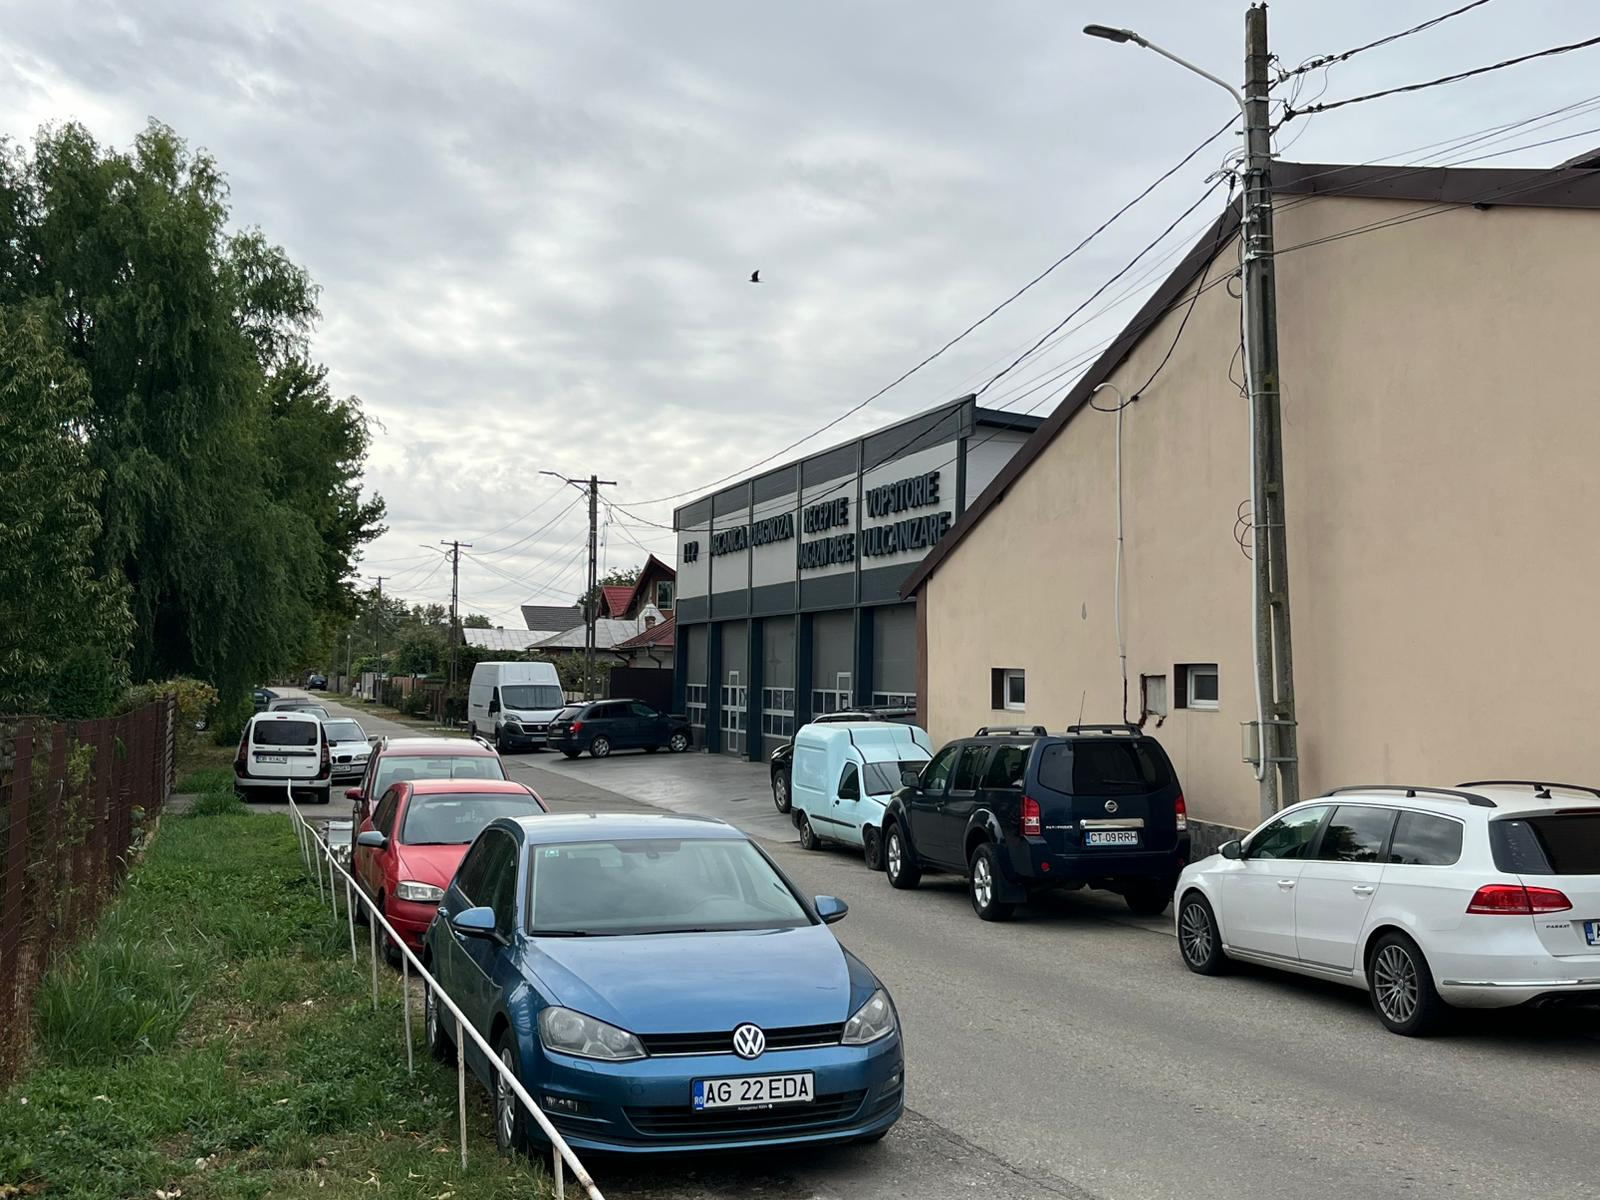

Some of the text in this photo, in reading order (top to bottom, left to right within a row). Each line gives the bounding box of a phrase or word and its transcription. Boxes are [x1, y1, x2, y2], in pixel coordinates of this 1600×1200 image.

[865, 471, 940, 517] VOPSITORIE
[750, 513, 794, 547] DIAGNOZA
[804, 497, 849, 533] RECEPTIE
[829, 533, 855, 564] PIESE
[861, 511, 951, 557] VULCANIZARE
[1090, 833, 1103, 843] CT
[705, 1076, 809, 1104] AG 22 EDA
